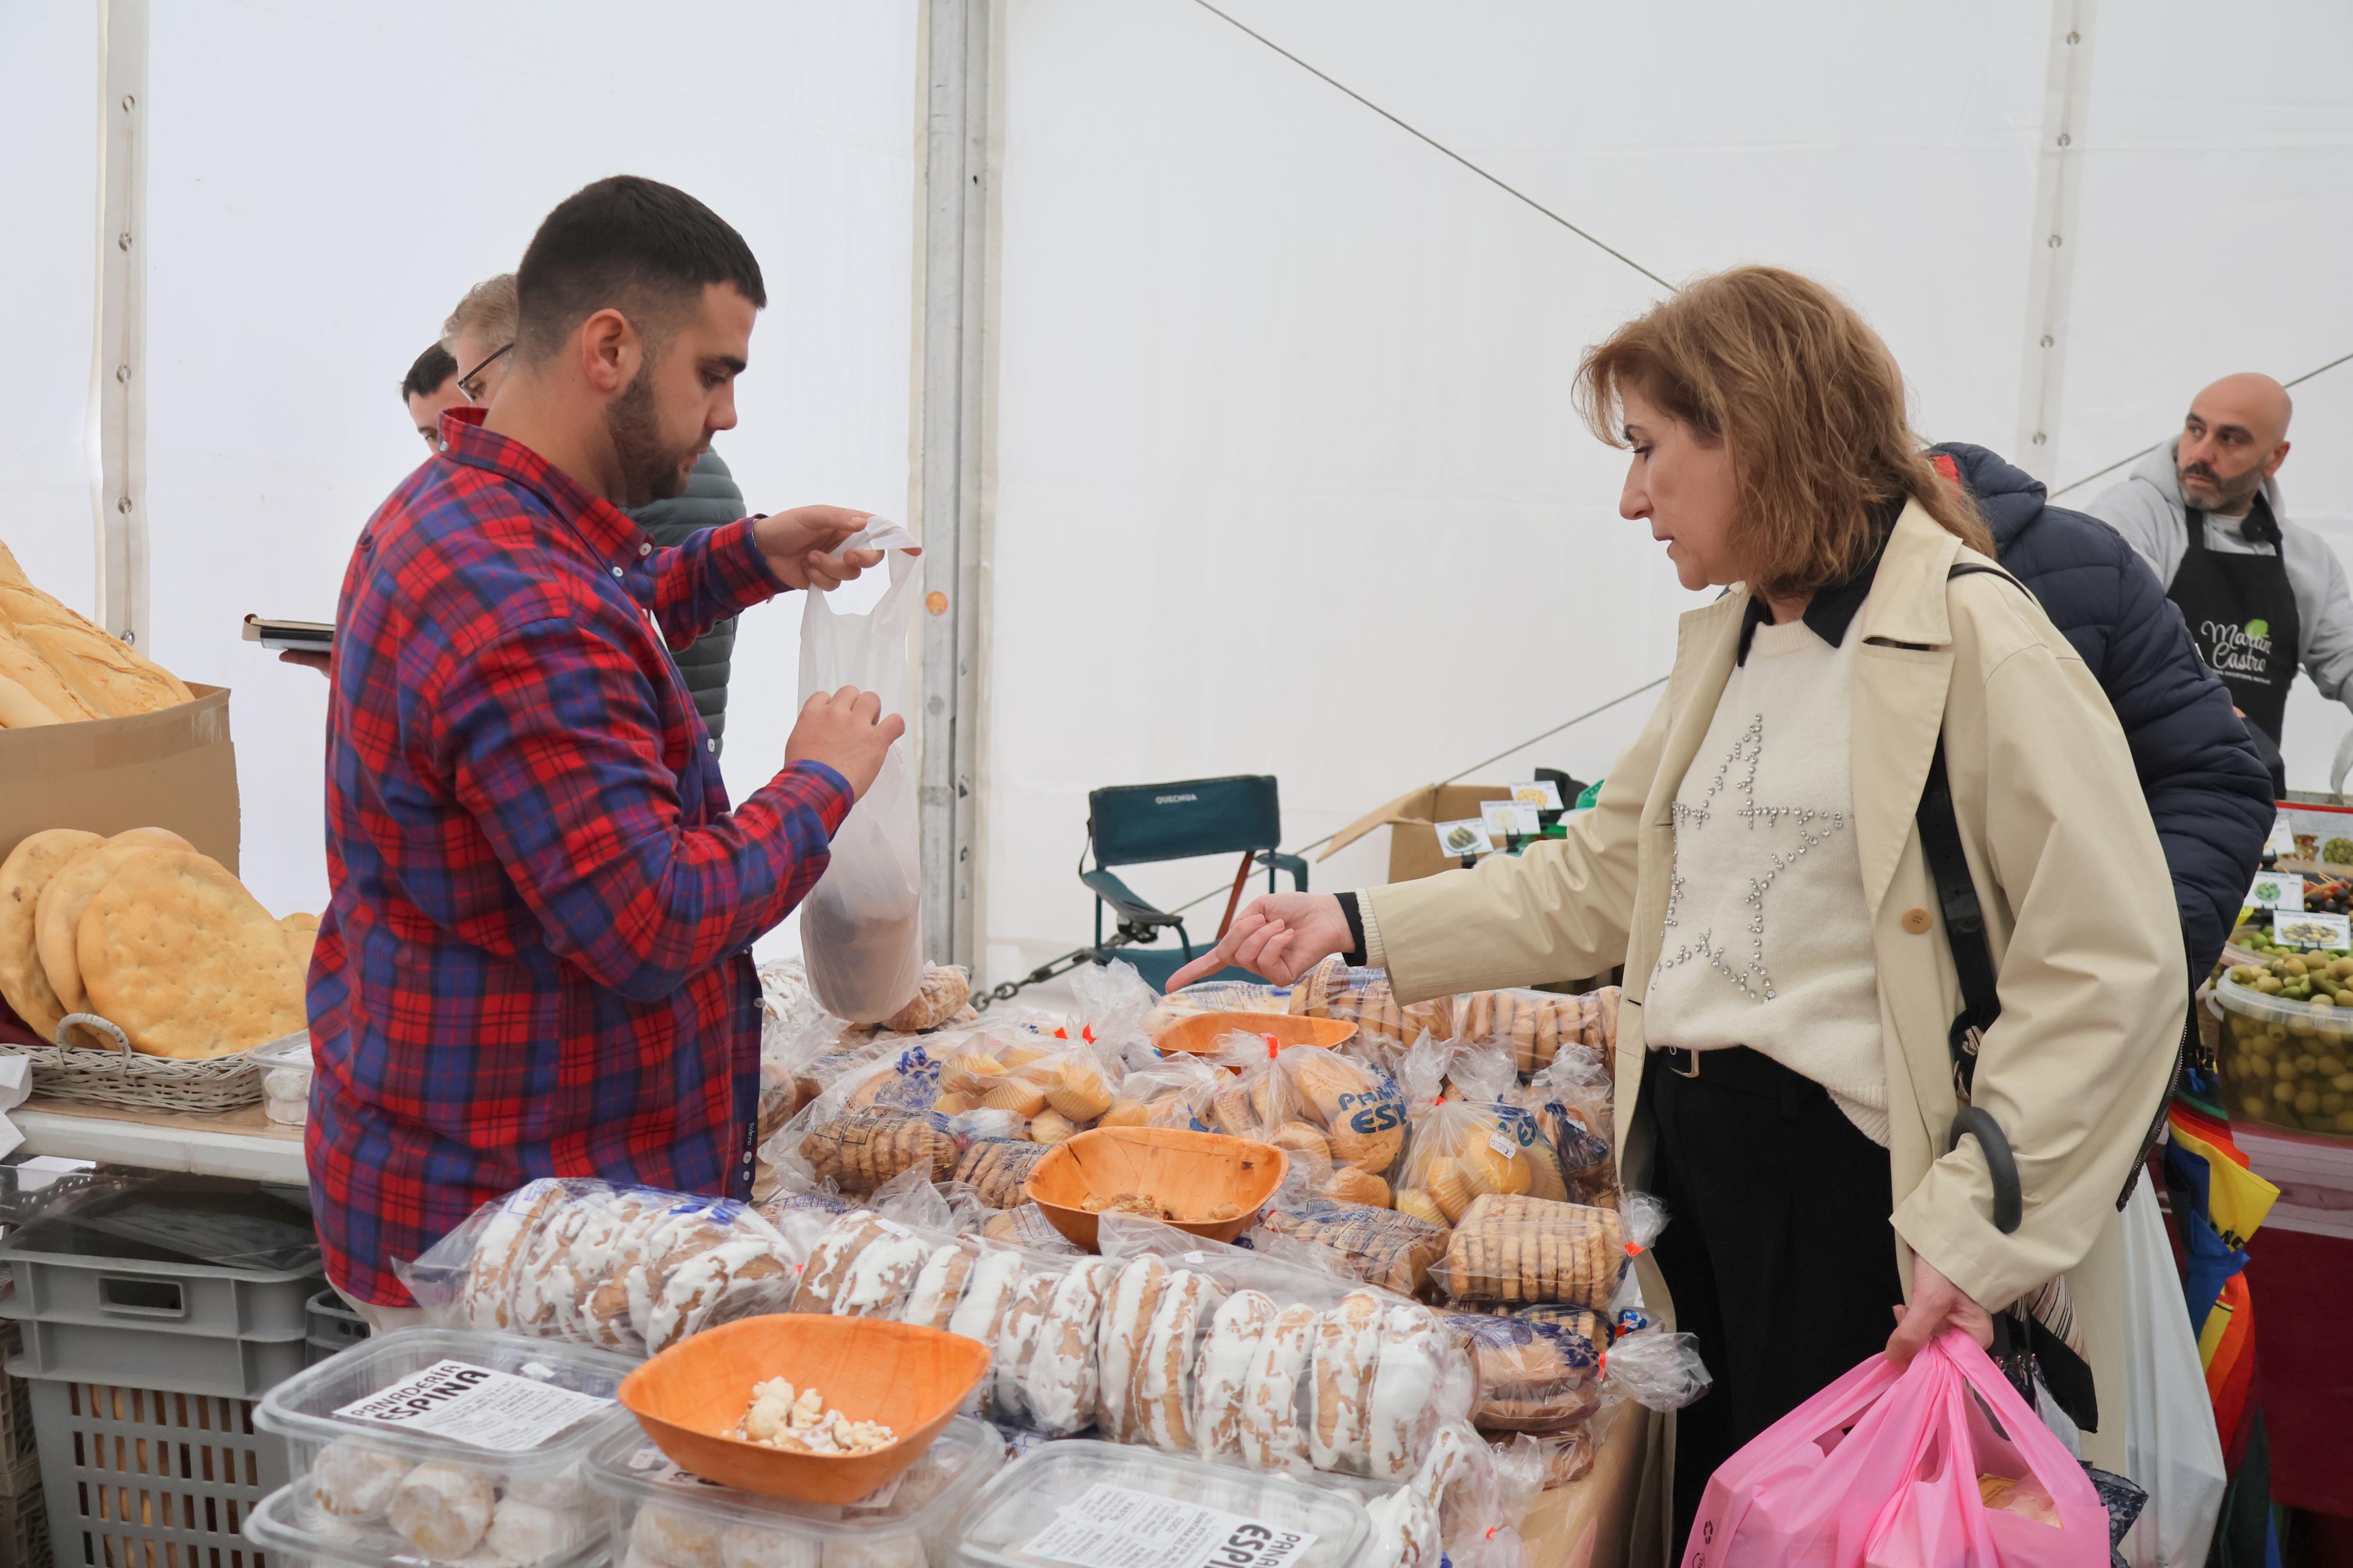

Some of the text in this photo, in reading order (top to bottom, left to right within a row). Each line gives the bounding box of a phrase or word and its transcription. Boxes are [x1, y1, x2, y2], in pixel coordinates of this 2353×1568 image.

[2212, 641, 2266, 672] Castro
[1155, 794, 1198, 805] QUECHUA
[352, 1364, 462, 1416] PANADERÍA
[374, 1370, 492, 1421] ESPINA
[1202, 1524, 1272, 1568] ESPI
[1252, 1532, 1301, 1568] PANA
